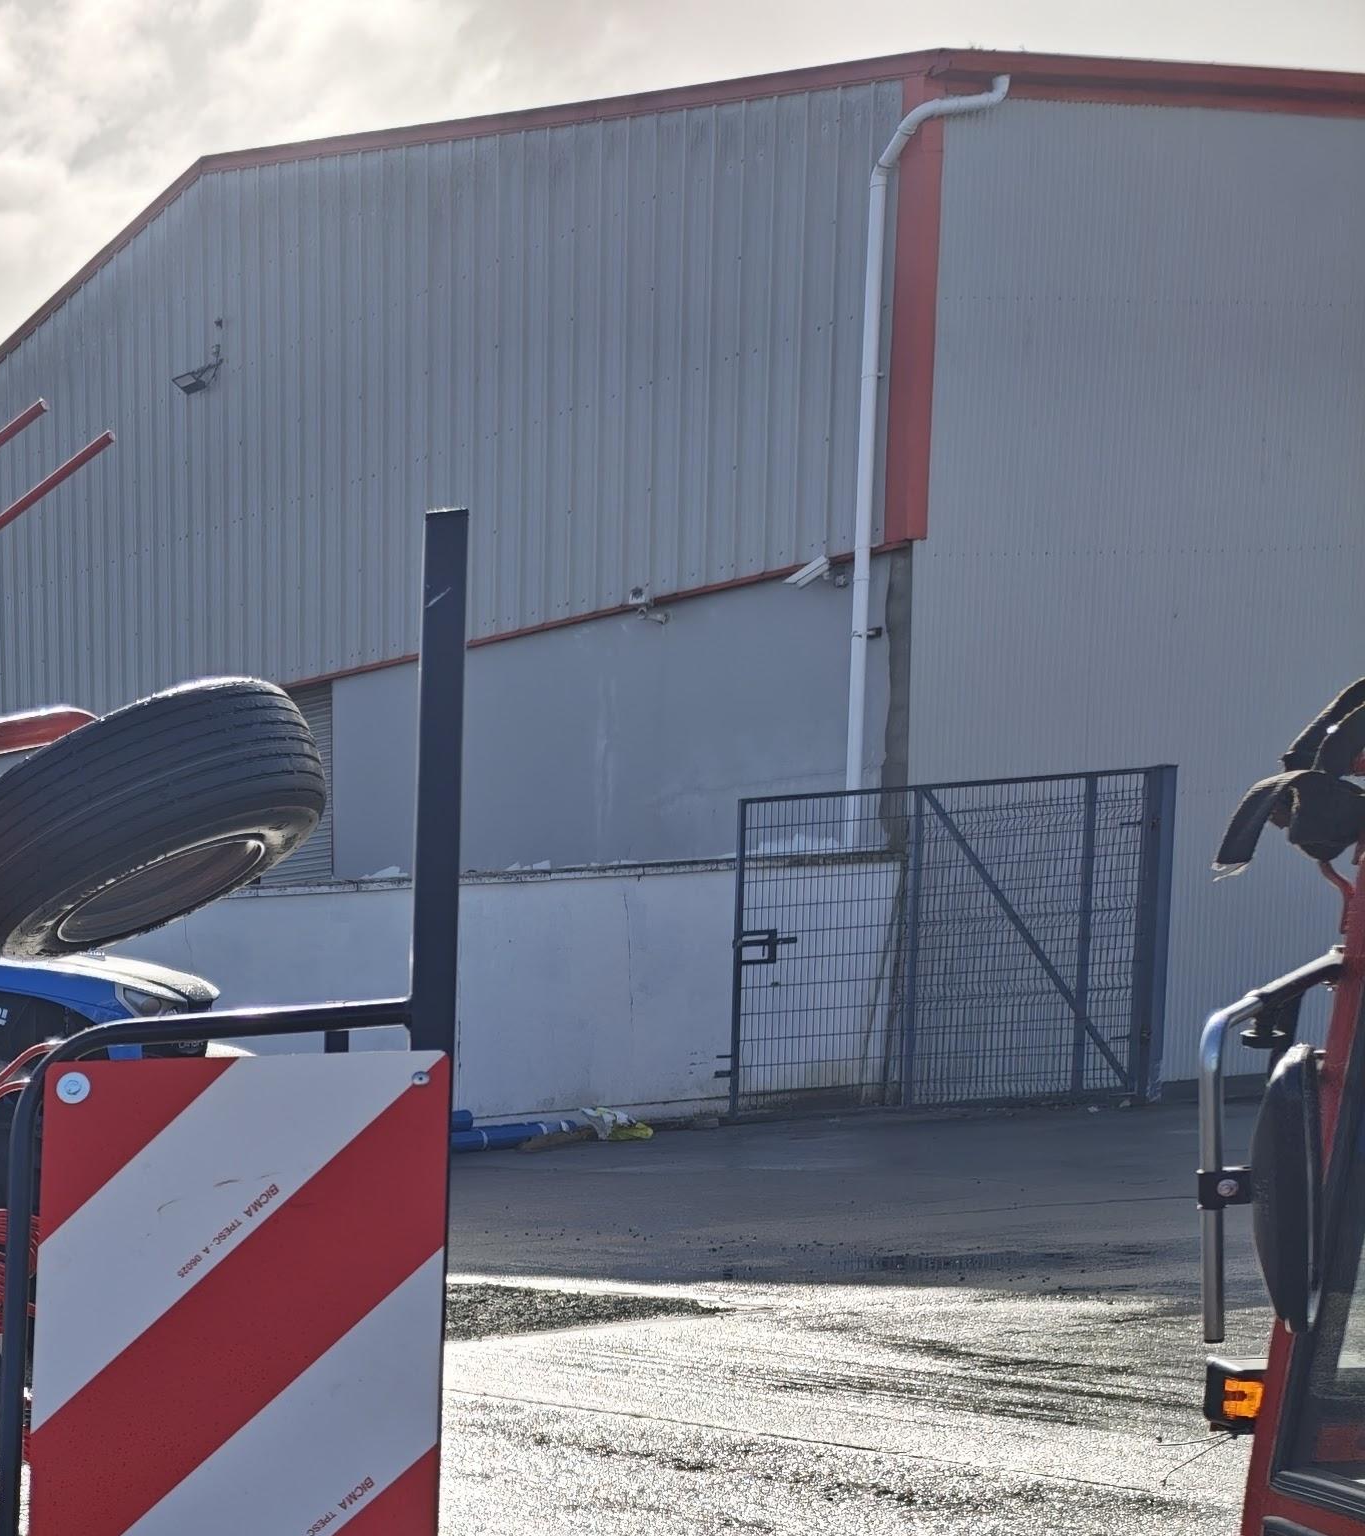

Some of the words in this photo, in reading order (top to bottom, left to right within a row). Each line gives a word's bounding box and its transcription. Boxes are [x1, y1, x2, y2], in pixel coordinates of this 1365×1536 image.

[243, 1183, 280, 1217] BICMA
[177, 1254, 203, 1278] 06025
[337, 1476, 375, 1510] BICMA
